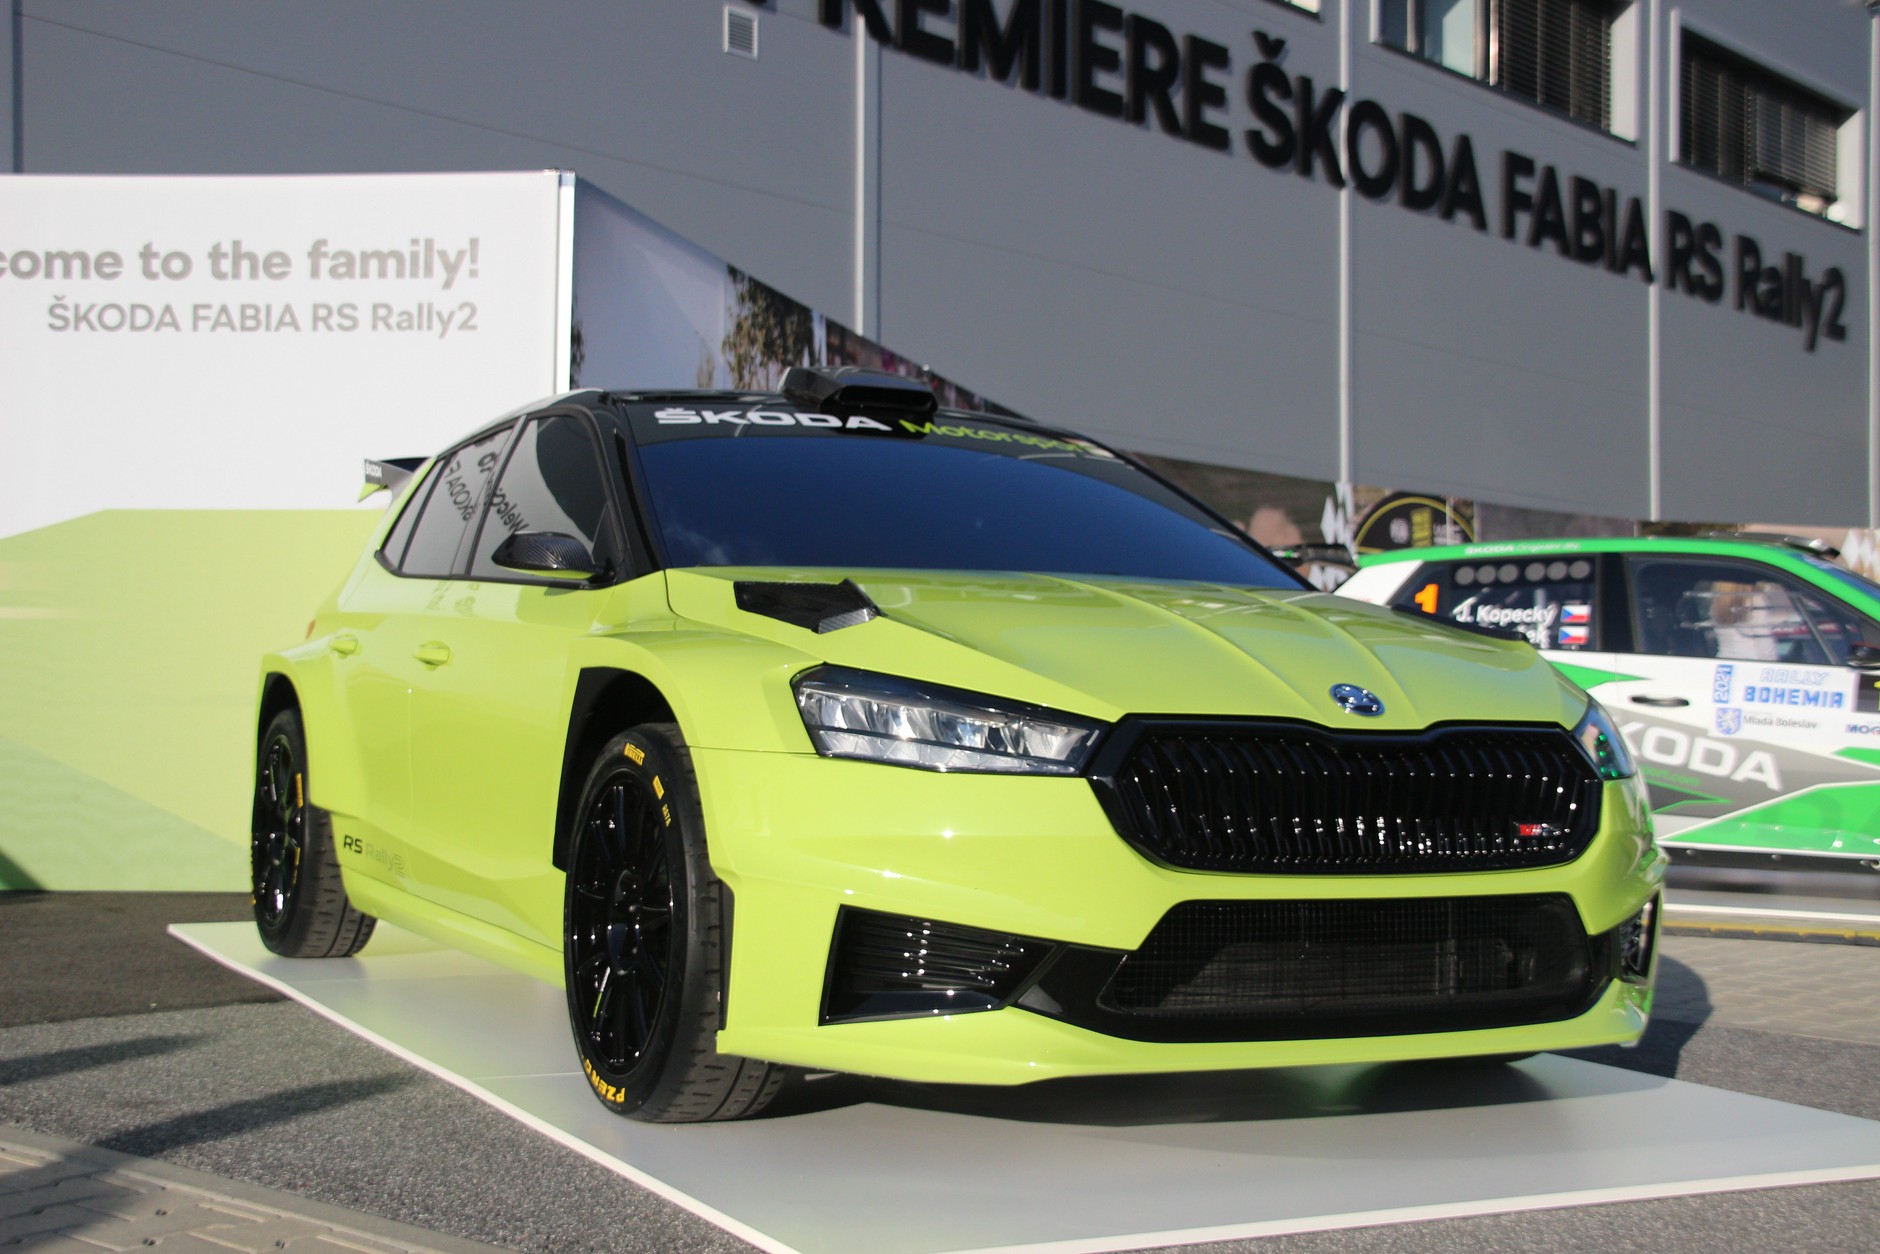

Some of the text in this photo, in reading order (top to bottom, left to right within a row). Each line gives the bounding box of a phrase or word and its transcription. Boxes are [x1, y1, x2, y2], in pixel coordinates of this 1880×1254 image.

[1244, 29, 1488, 232] ŠKODA
[1498, 150, 1656, 286] FABIA
[1661, 208, 1724, 304] RS
[1731, 234, 1847, 352] Rally2
[139, 240, 194, 281] to
[208, 239, 292, 281] the
[307, 237, 480, 291] family!
[48, 294, 478, 340] ŠKODA FABIA RS Rally2
[653, 407, 894, 431] ŠKODA
[1414, 583, 1440, 615] 1
[1455, 603, 1475, 623] J.
[1743, 685, 1845, 709] BOHEMIA
[1617, 721, 1785, 792] KODA
[343, 834, 364, 854] RS
